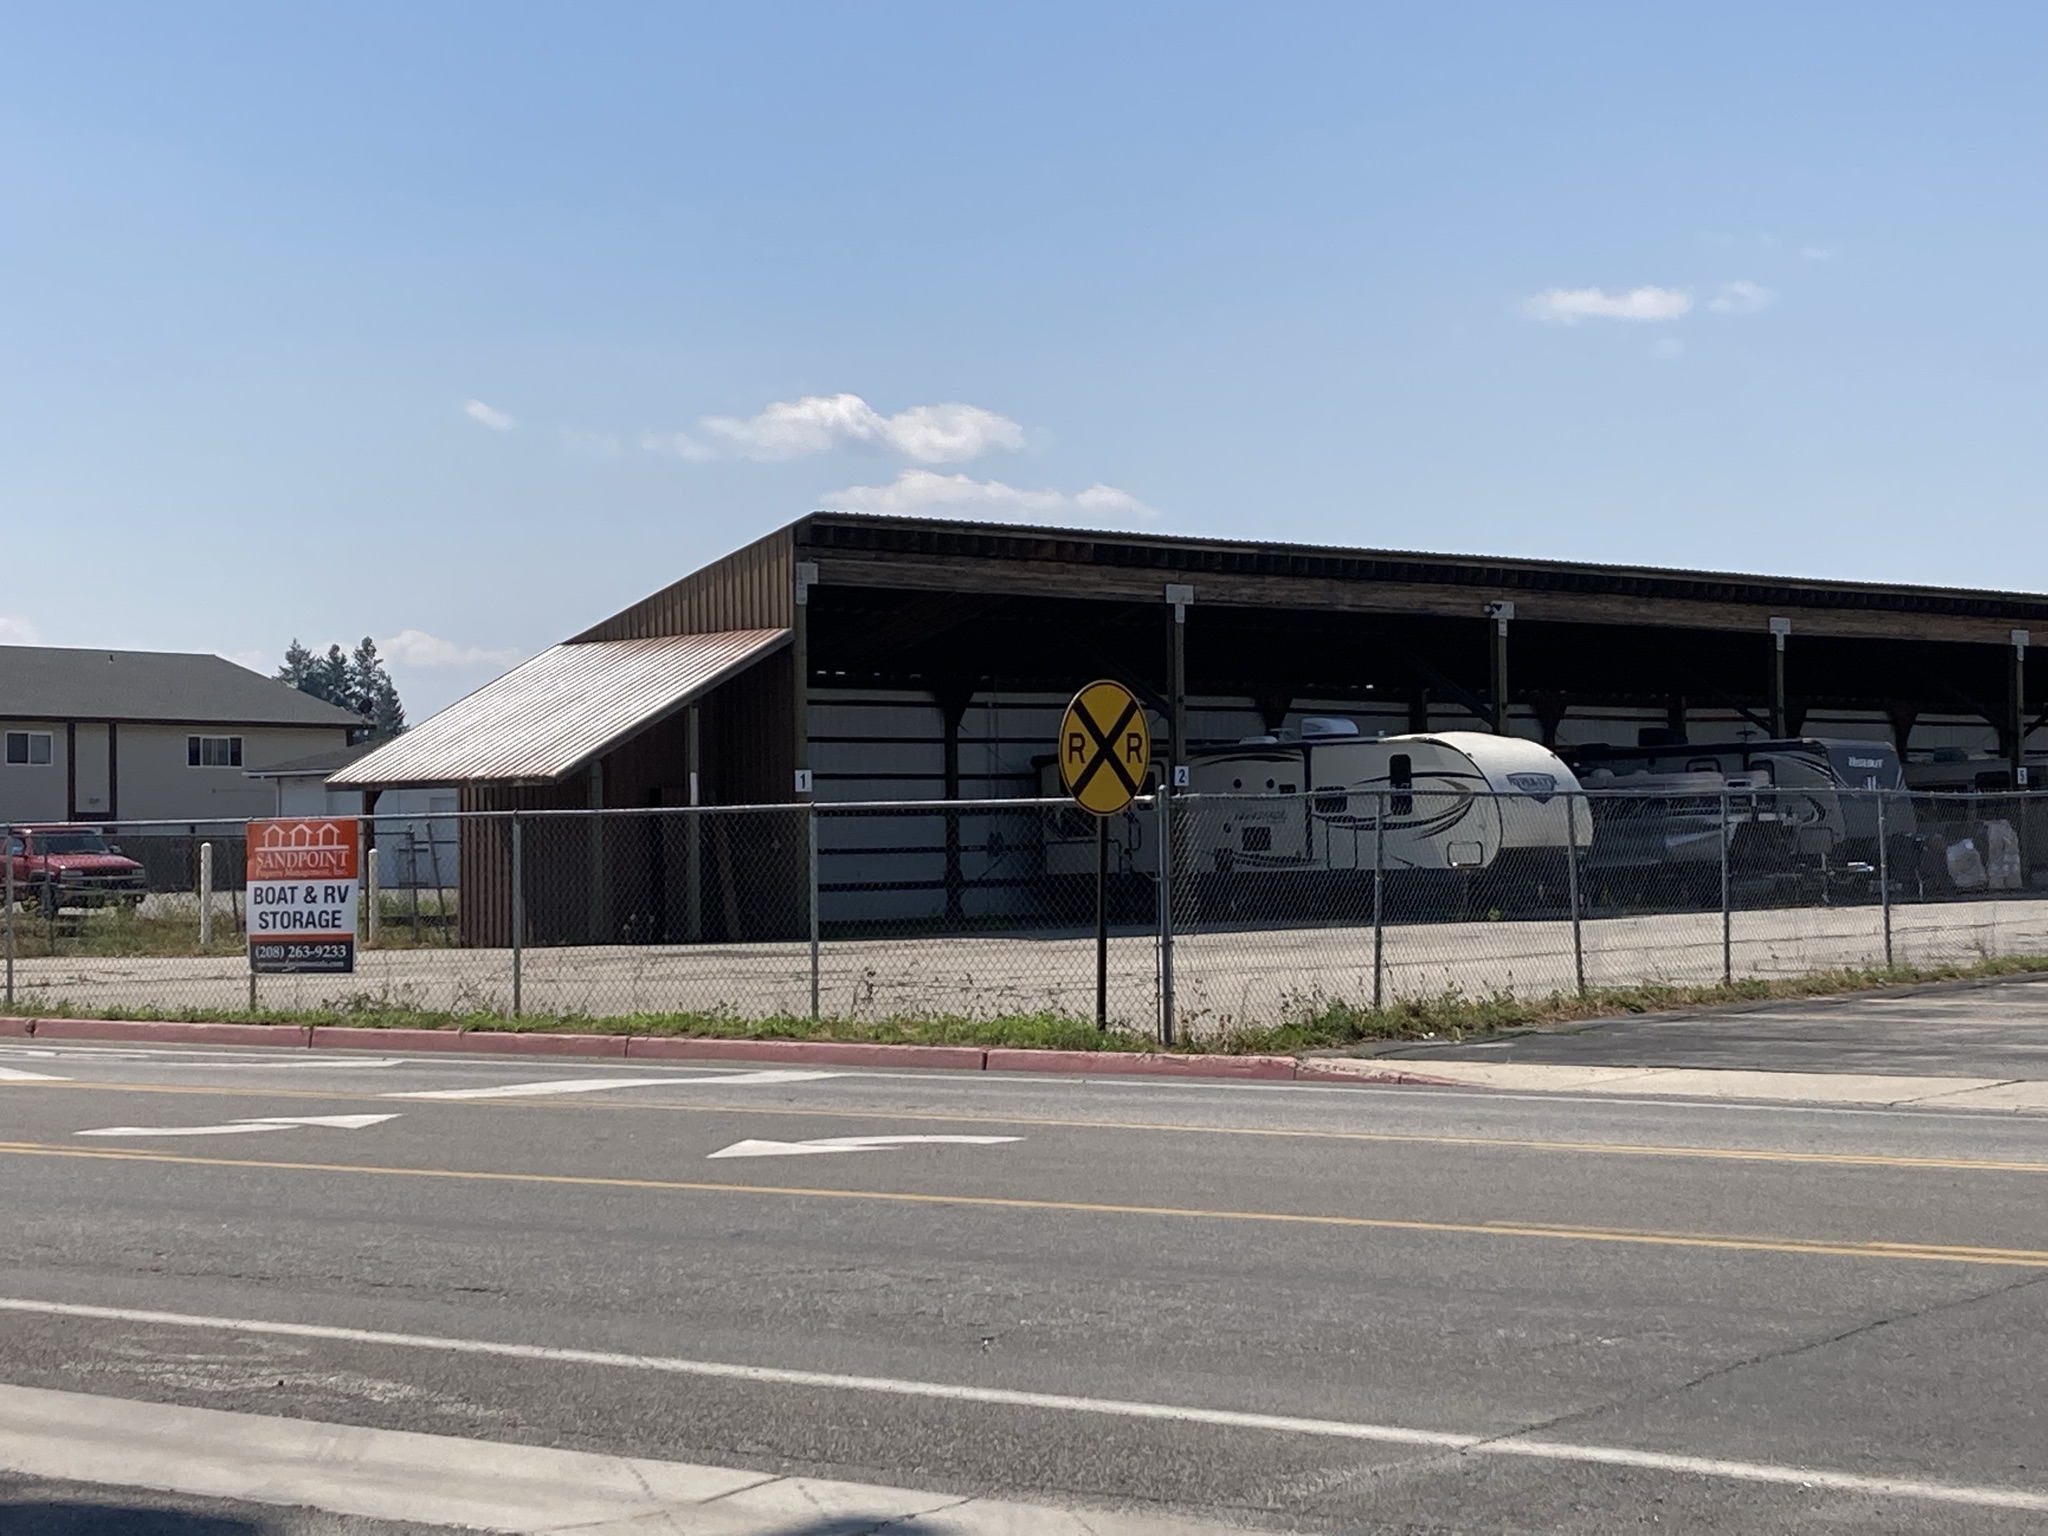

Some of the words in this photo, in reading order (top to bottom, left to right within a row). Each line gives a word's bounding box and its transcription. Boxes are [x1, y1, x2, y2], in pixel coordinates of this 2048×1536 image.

[1068, 732, 1086, 764] R
[1126, 732, 1143, 764] R
[1178, 768, 1186, 784] 2
[256, 850, 350, 869] SANDPOINT
[253, 885, 298, 905] BOAT
[303, 885, 318, 904] &
[324, 885, 350, 904] RV
[258, 910, 342, 929] STORAGE
[255, 945, 285, 959] (208)
[288, 944, 347, 958] 263-9233
